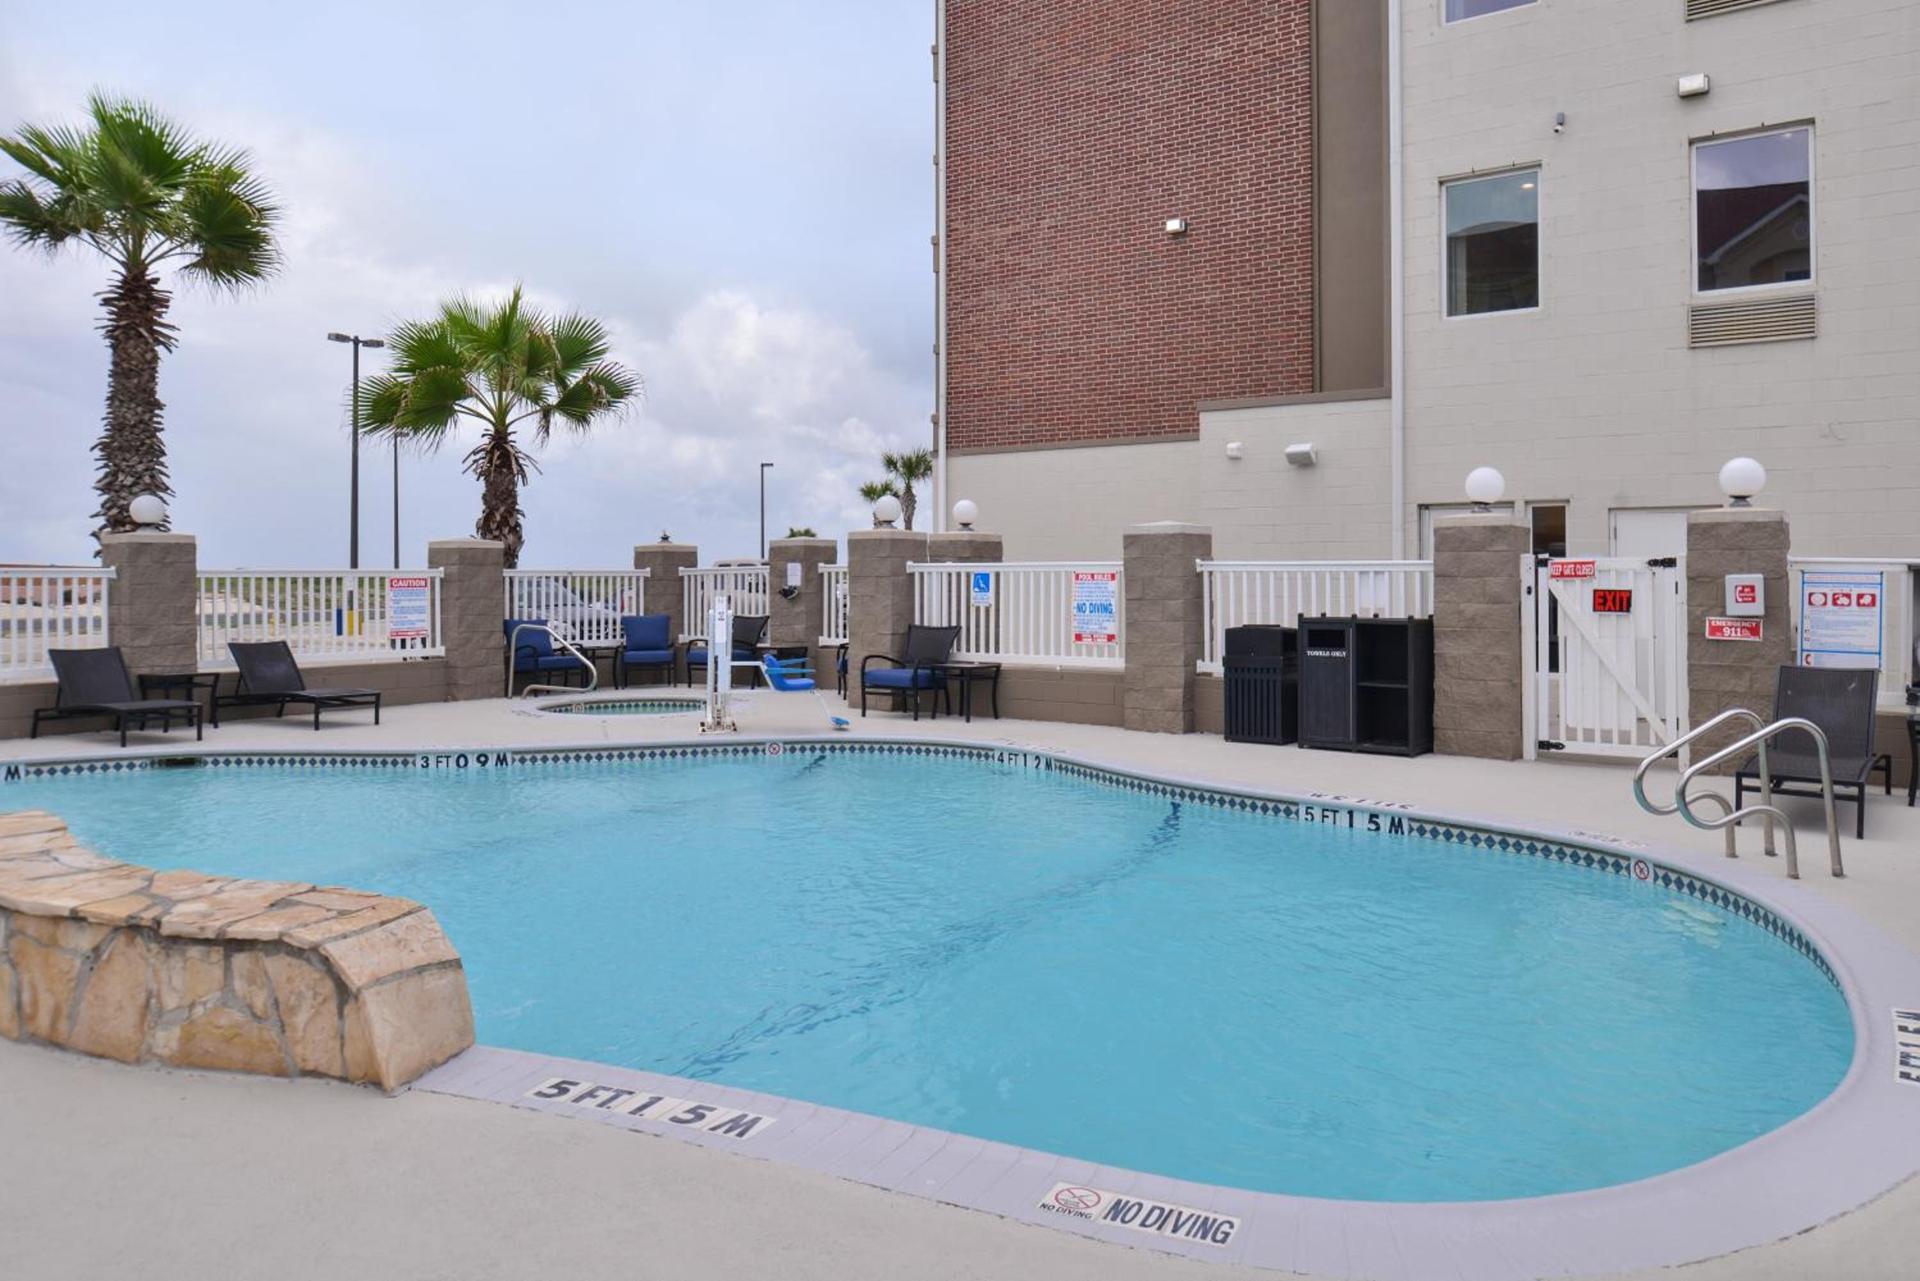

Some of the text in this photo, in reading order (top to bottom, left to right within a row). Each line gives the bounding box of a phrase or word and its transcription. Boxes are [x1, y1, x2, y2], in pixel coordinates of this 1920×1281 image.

[392, 579, 426, 587] CAUTION
[1076, 602, 1113, 614] NO DIVING
[1596, 591, 1630, 611] EXIT
[1711, 620, 1757, 628] EMERGENCY
[1723, 626, 1741, 637] 911
[1331, 650, 1347, 659] ONLY
[420, 755, 430, 769] 3
[436, 754, 452, 769] FT
[476, 753, 490, 767] 9
[495, 752, 509, 767] M
[997, 751, 1004, 764] 4
[1008, 752, 1019, 767] FT
[1034, 755, 1041, 769] 2
[1045, 756, 1053, 773] M
[4, 765, 21, 781] M
[1304, 806, 1405, 836] 5 FT 1 5 M
[533, 1080, 581, 1099] 5
[667, 1104, 717, 1124] 5
[707, 1113, 763, 1138] M
[1039, 1202, 1093, 1220] NO DIVING
[1103, 1198, 1235, 1245] NO DIVING
